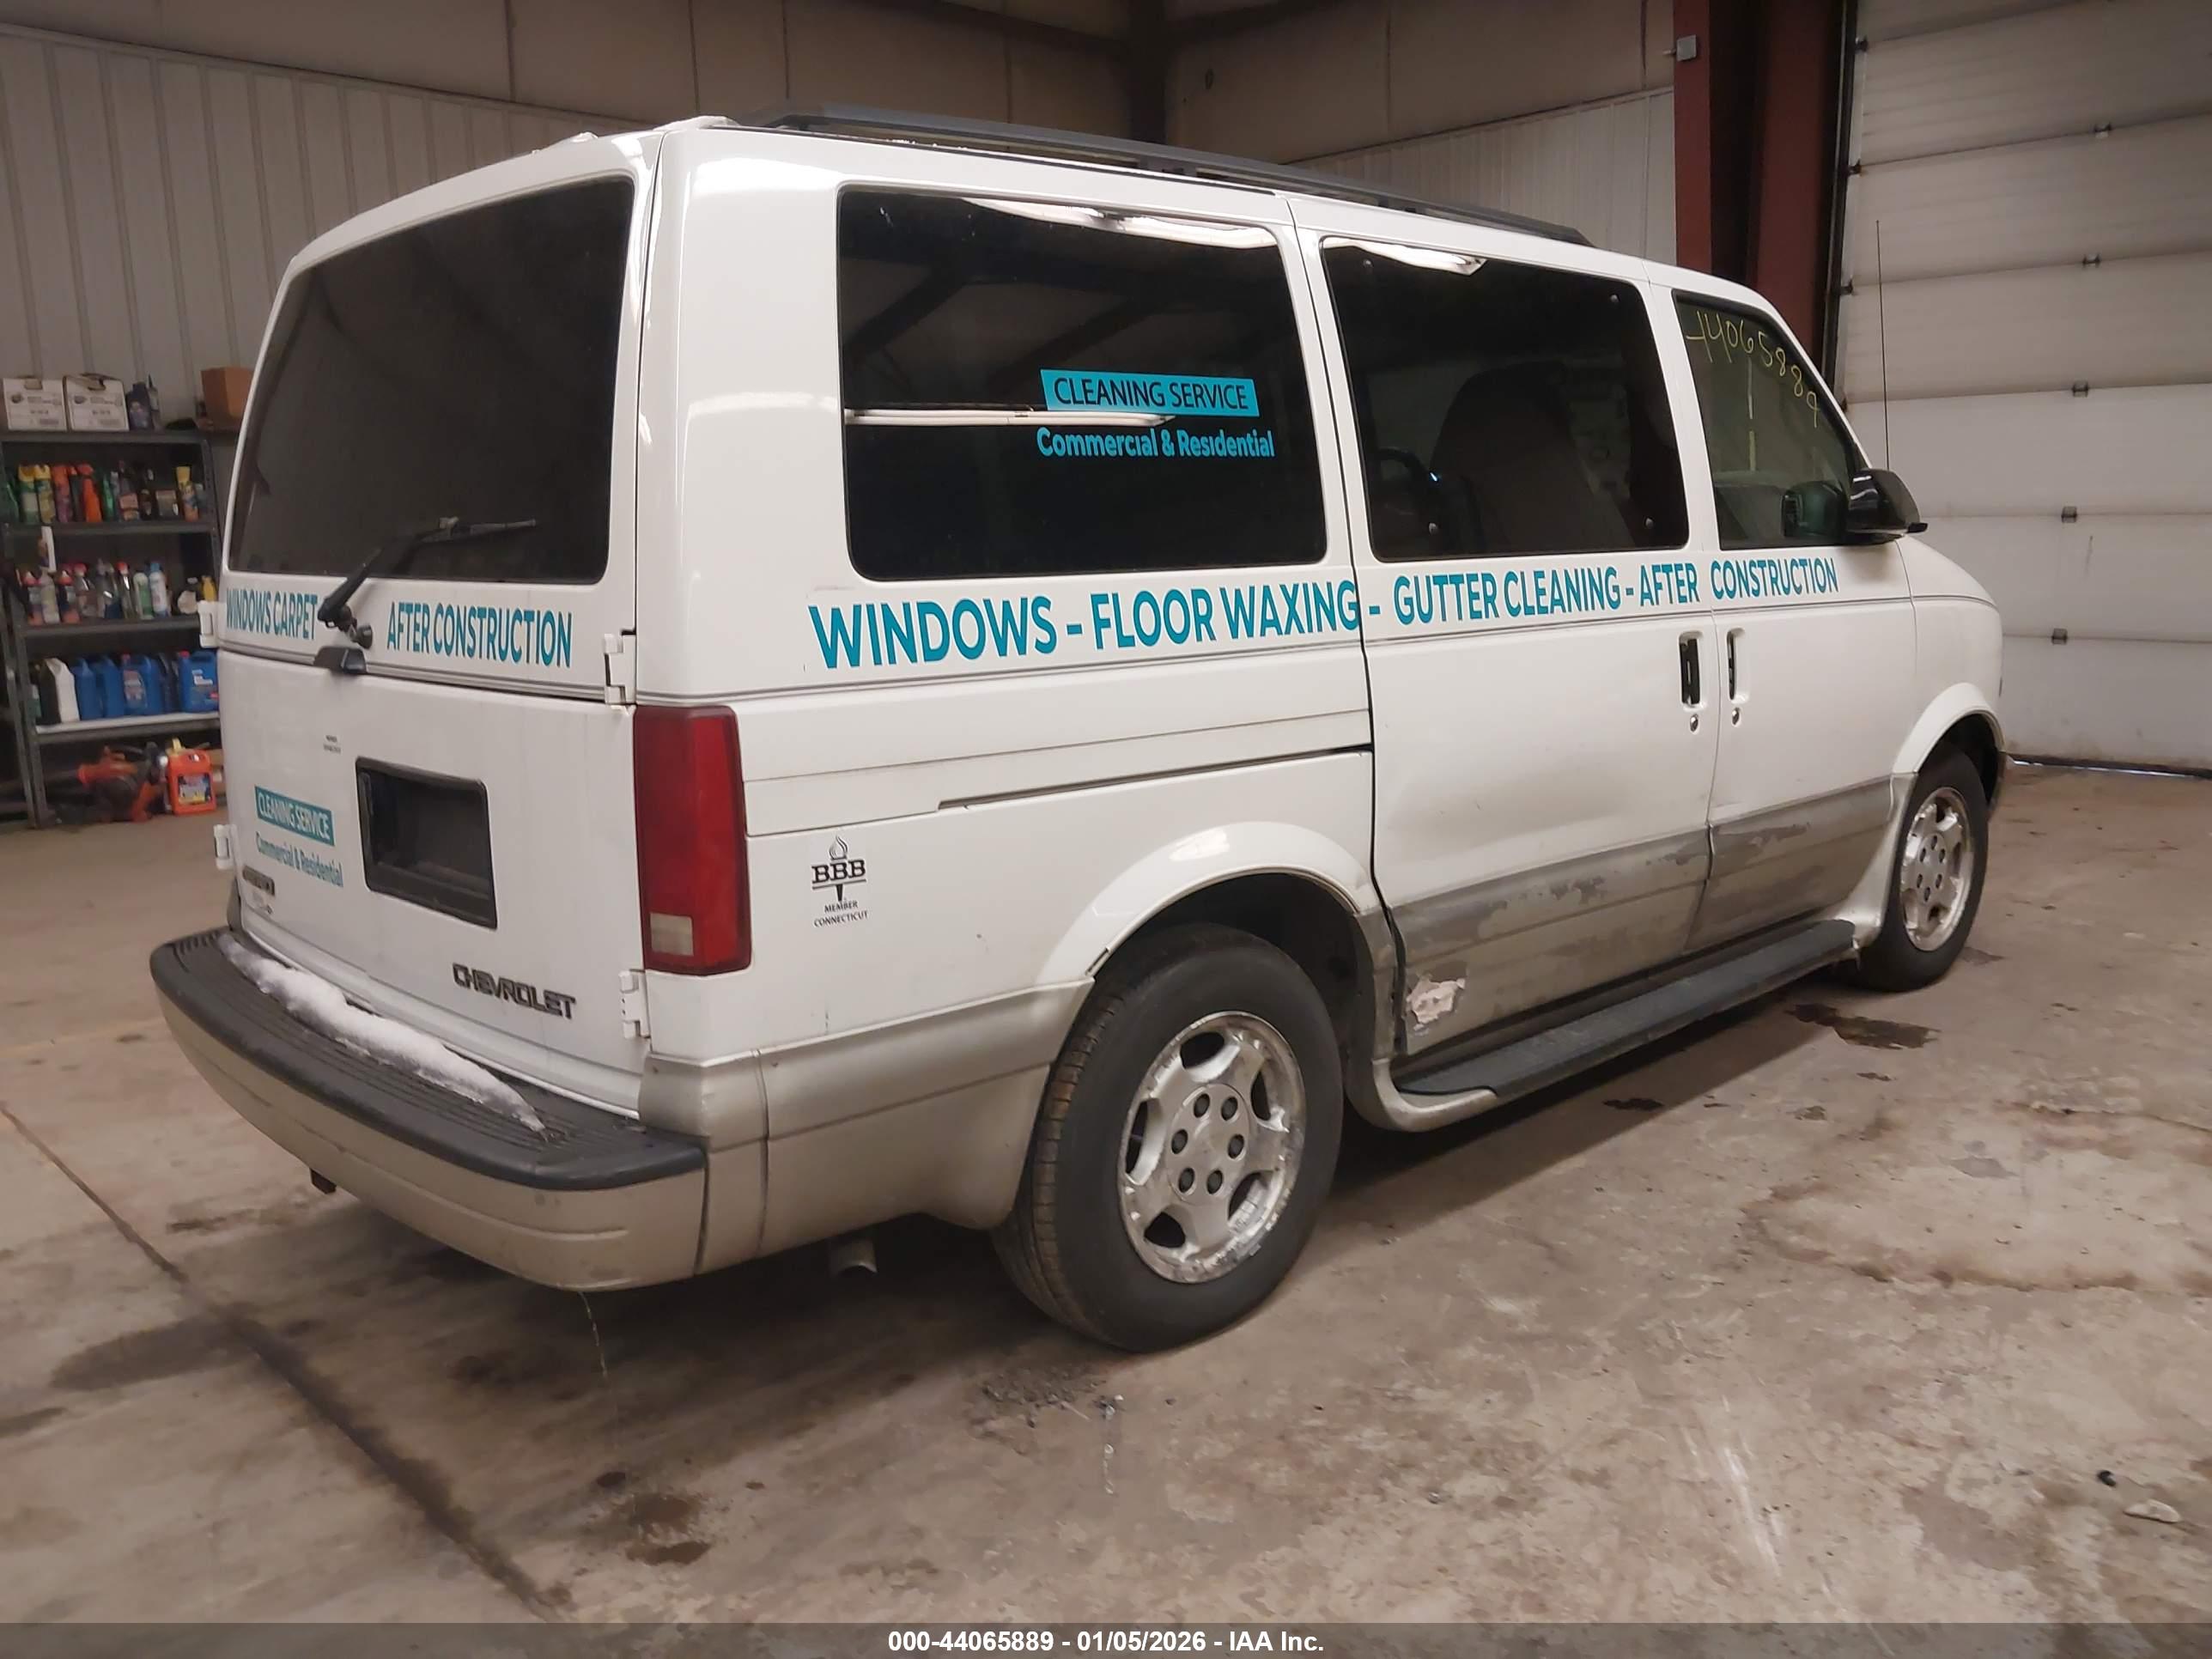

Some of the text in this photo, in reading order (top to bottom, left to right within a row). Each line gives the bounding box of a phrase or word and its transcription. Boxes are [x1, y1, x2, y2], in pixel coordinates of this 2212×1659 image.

[1054, 377, 1249, 410] CLEANING SERVICE
[1036, 427, 1275, 457] Commercial & Residential
[227, 588, 318, 640] WINDOWS CARPET
[808, 595, 1057, 669] WINDOWS
[1090, 587, 1216, 650] FLOOR
[1219, 580, 1360, 640] WAXING
[1393, 570, 1499, 625] GUTTER
[1504, 566, 1621, 616] CLEANING
[1639, 562, 1700, 606] AFTER
[1710, 557, 1839, 599] CONSTRUCTION
[386, 601, 572, 668] AFTER CONSTRUCTION
[295, 805, 331, 840] SERVICE
[811, 859, 866, 884] BBB
[814, 910, 868, 927] CONNECTICUT
[824, 900, 858, 913] MEMBER
[453, 963, 576, 1020] CHEVROLET
